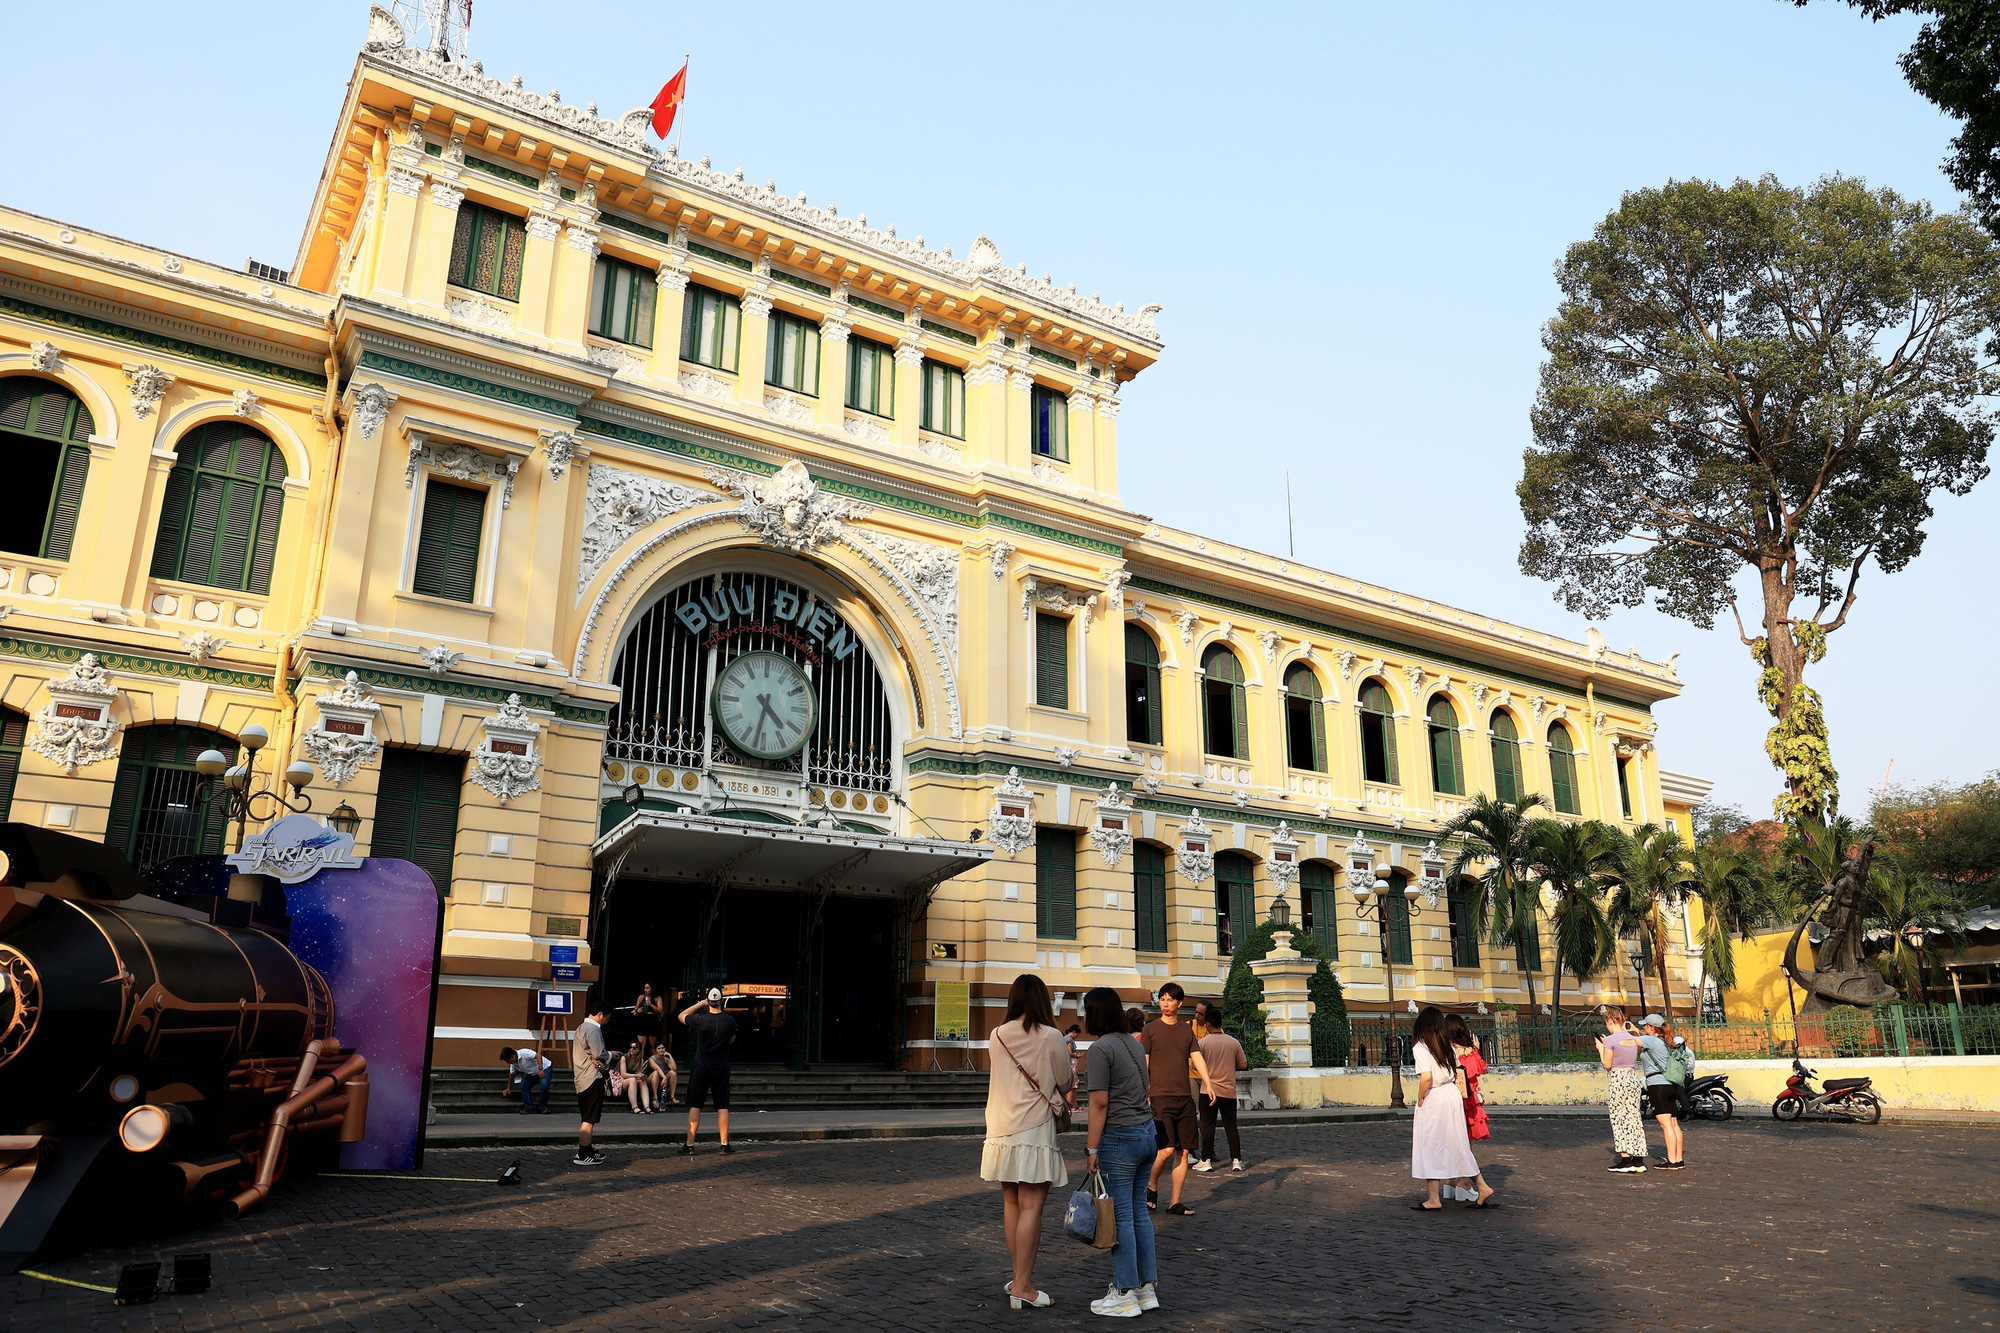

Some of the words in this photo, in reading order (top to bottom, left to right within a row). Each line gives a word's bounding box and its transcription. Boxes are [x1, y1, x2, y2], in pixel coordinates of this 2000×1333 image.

[675, 585, 755, 635] BƯU
[773, 589, 859, 661] ĐIỆN
[739, 619, 761, 634] PHỐ
[764, 622, 781, 636] HỒ
[62, 708, 85, 717] LOUIS
[728, 781, 749, 793] 1886
[762, 785, 779, 797] 1891
